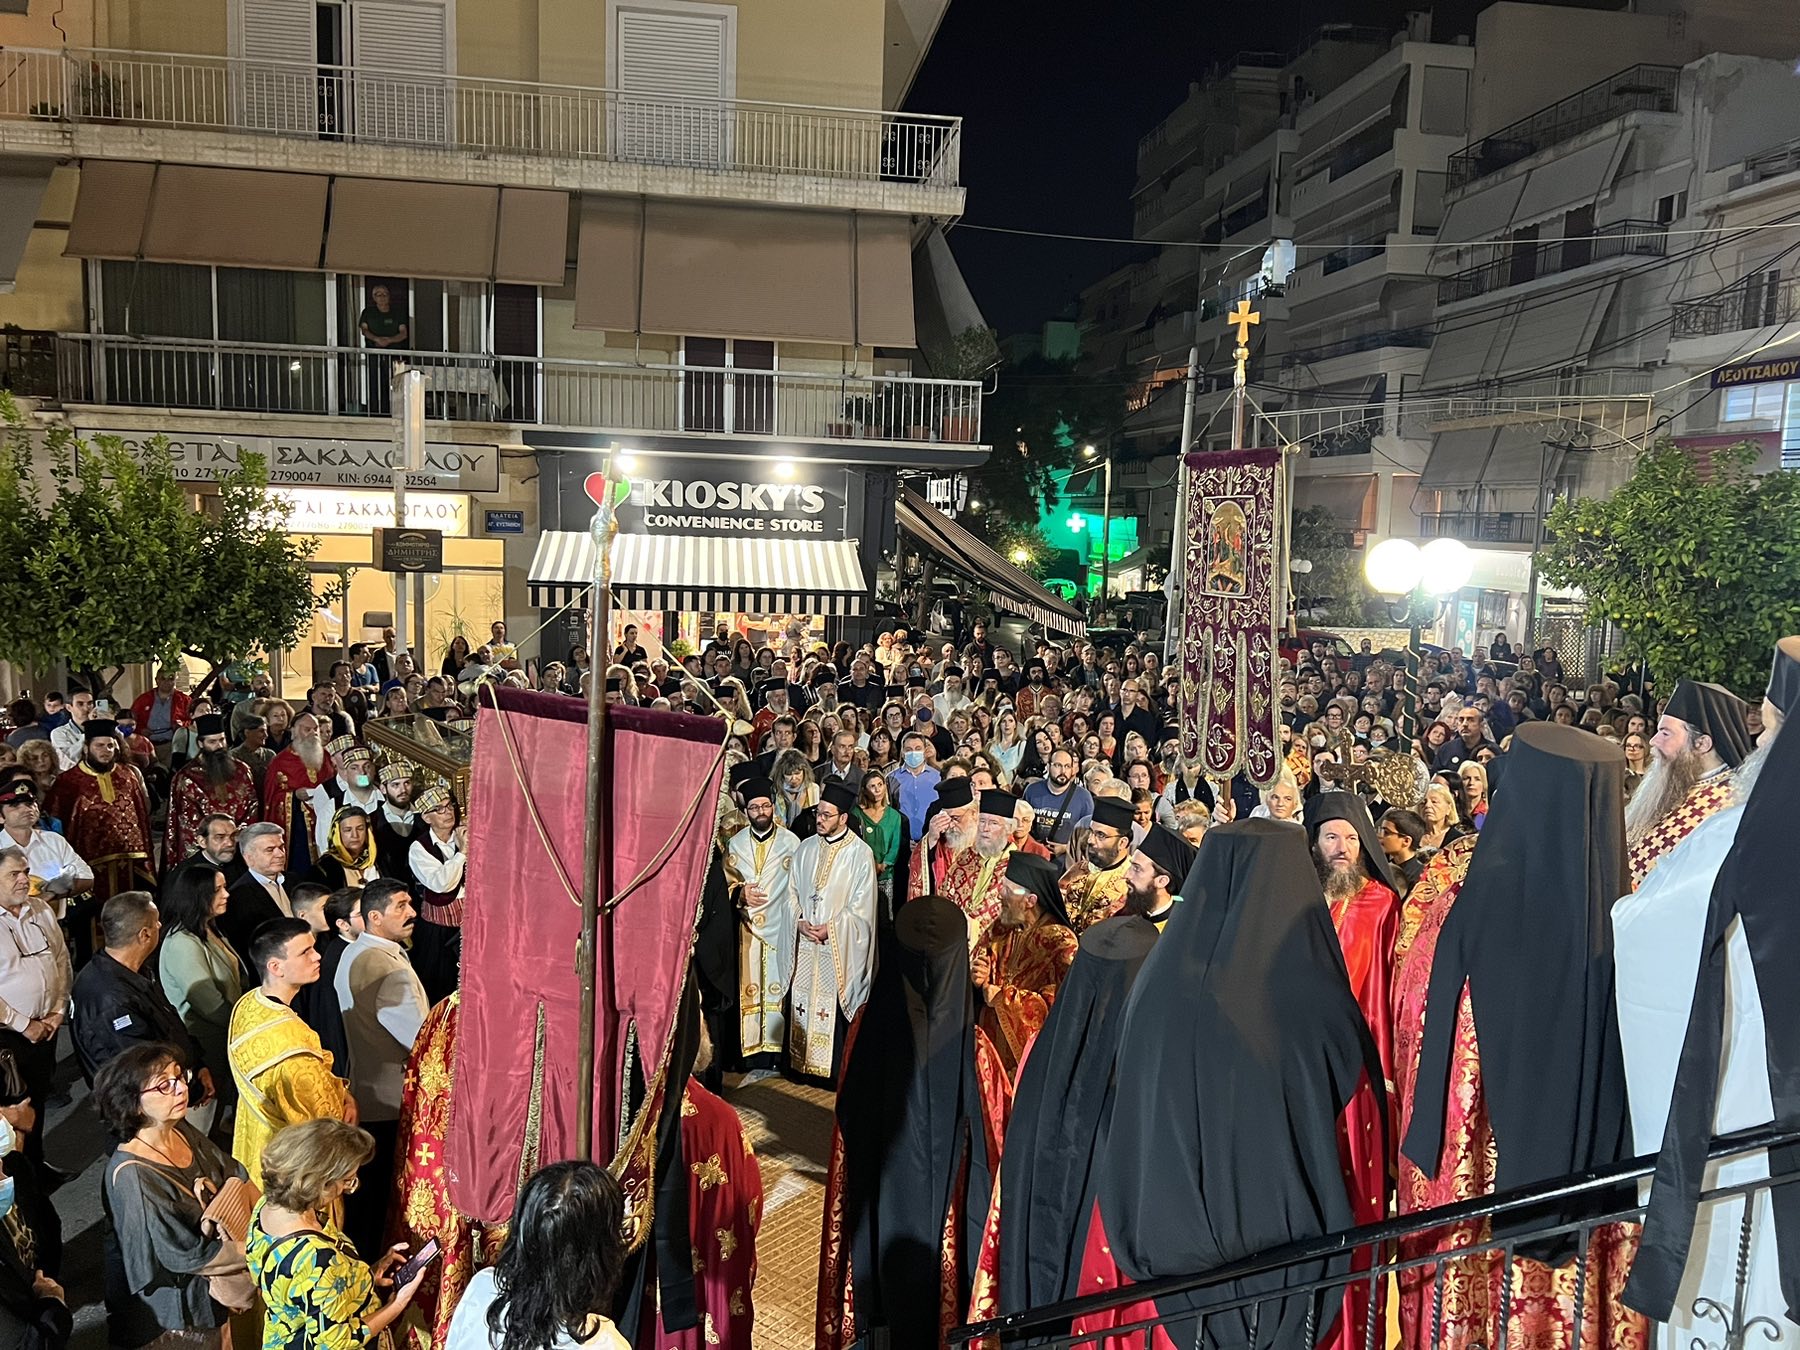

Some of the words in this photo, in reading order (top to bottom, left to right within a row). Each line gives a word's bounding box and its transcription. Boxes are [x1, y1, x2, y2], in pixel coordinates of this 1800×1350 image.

[277, 446, 485, 472] ΣΑΚΑΛΛΟΥ
[270, 470, 321, 482] 2790047
[363, 474, 437, 486] 694432564
[643, 480, 825, 513] KIOSKY'S
[643, 514, 764, 530] CONVENIENCE
[770, 519, 823, 532] STORE
[388, 549, 438, 557] ΔΗΜΗΤΡΗΣ
